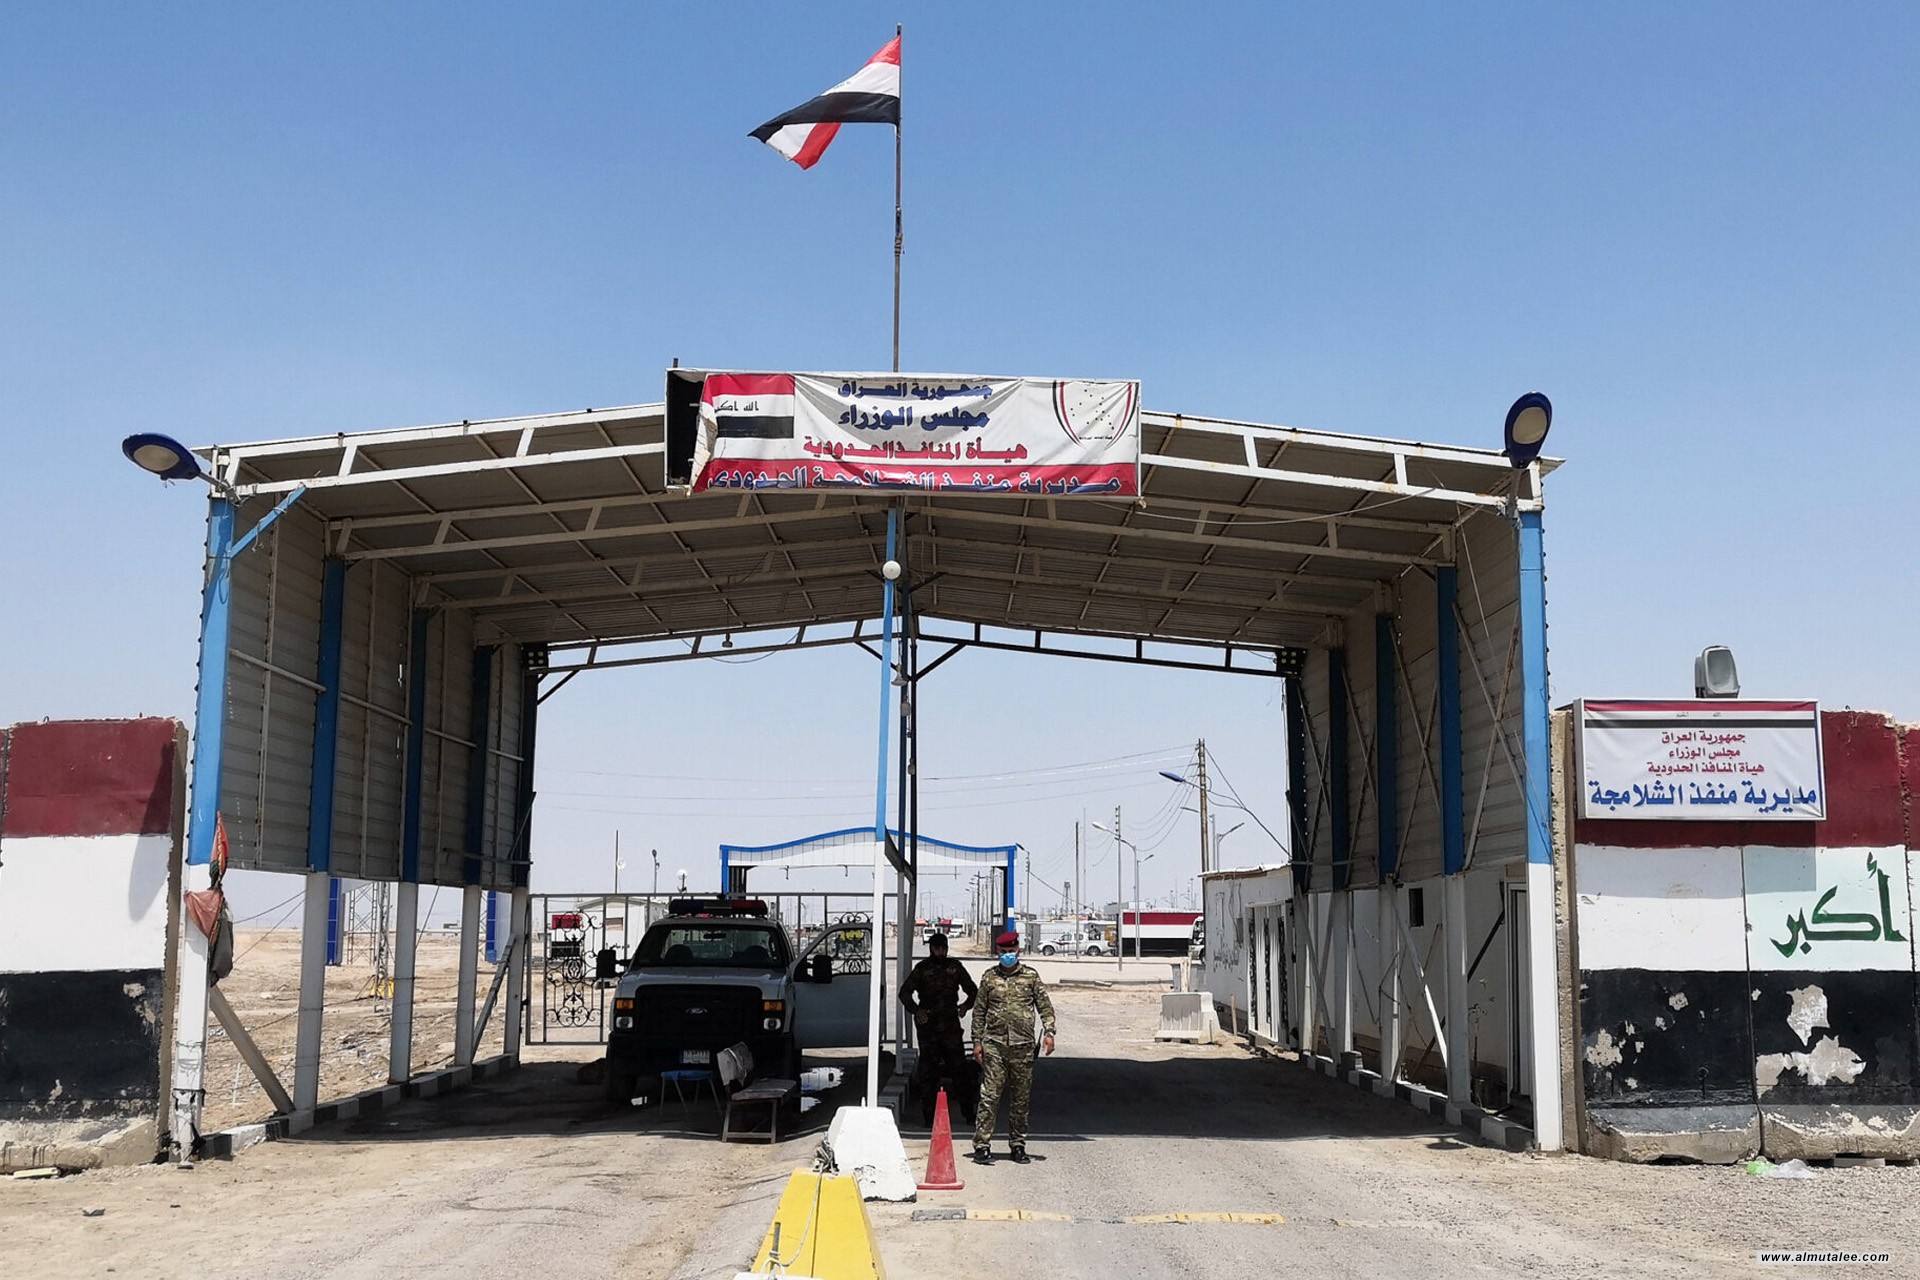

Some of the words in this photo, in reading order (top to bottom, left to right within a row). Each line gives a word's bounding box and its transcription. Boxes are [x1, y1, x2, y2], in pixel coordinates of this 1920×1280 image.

[837, 380, 908, 399] العراق
[910, 382, 993, 401] جمهورية
[838, 404, 913, 431] الوزراء
[920, 406, 990, 431] مجلس
[803, 435, 894, 460] الحدودية
[895, 440, 961, 461] المنافذ
[965, 436, 1028, 463] هيأة
[939, 471, 1013, 492] منفذ
[1661, 730, 1697, 744] العراق
[1699, 730, 1746, 745] جمهورية
[1668, 747, 1704, 760] الوزراء
[1708, 748, 1741, 760] مجلس
[1646, 760, 1699, 777] الحدودية
[1700, 761, 1737, 774] المنافذ
[1588, 779, 1684, 812] الشلامجة
[1689, 780, 1738, 806] منفذ
[1741, 779, 1817, 814] مديرية
[1769, 851, 1909, 959] أكبر
